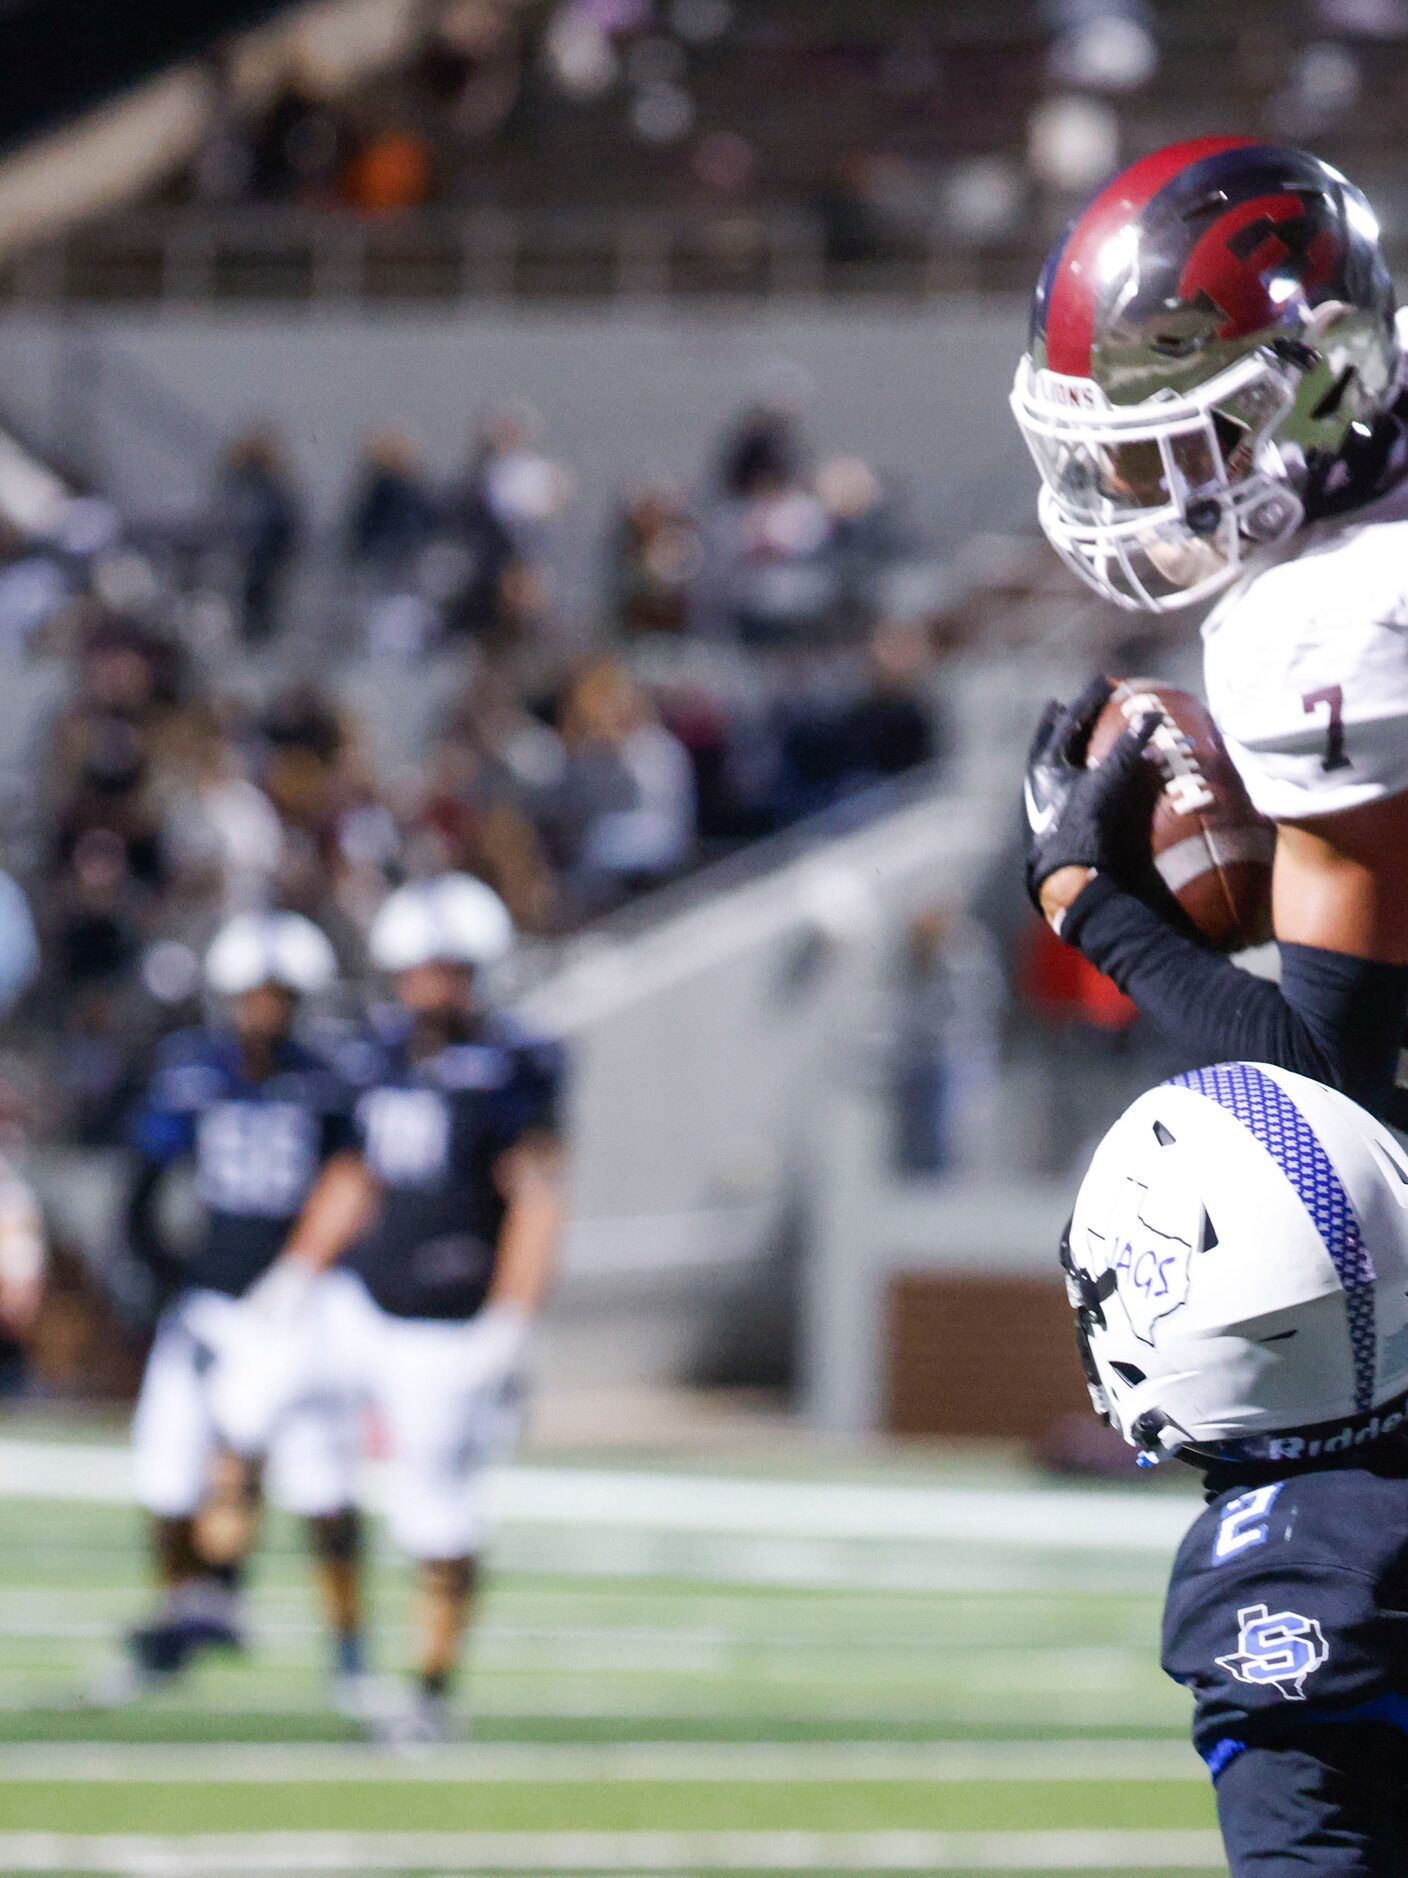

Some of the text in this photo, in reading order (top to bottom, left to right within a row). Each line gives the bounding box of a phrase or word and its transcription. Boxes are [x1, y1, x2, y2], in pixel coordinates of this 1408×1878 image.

[1302, 683, 1353, 773] 7
[1105, 1236, 1175, 1299] JAGS
[1211, 1481, 1285, 1568] 2
[1238, 1611, 1316, 1686] S
